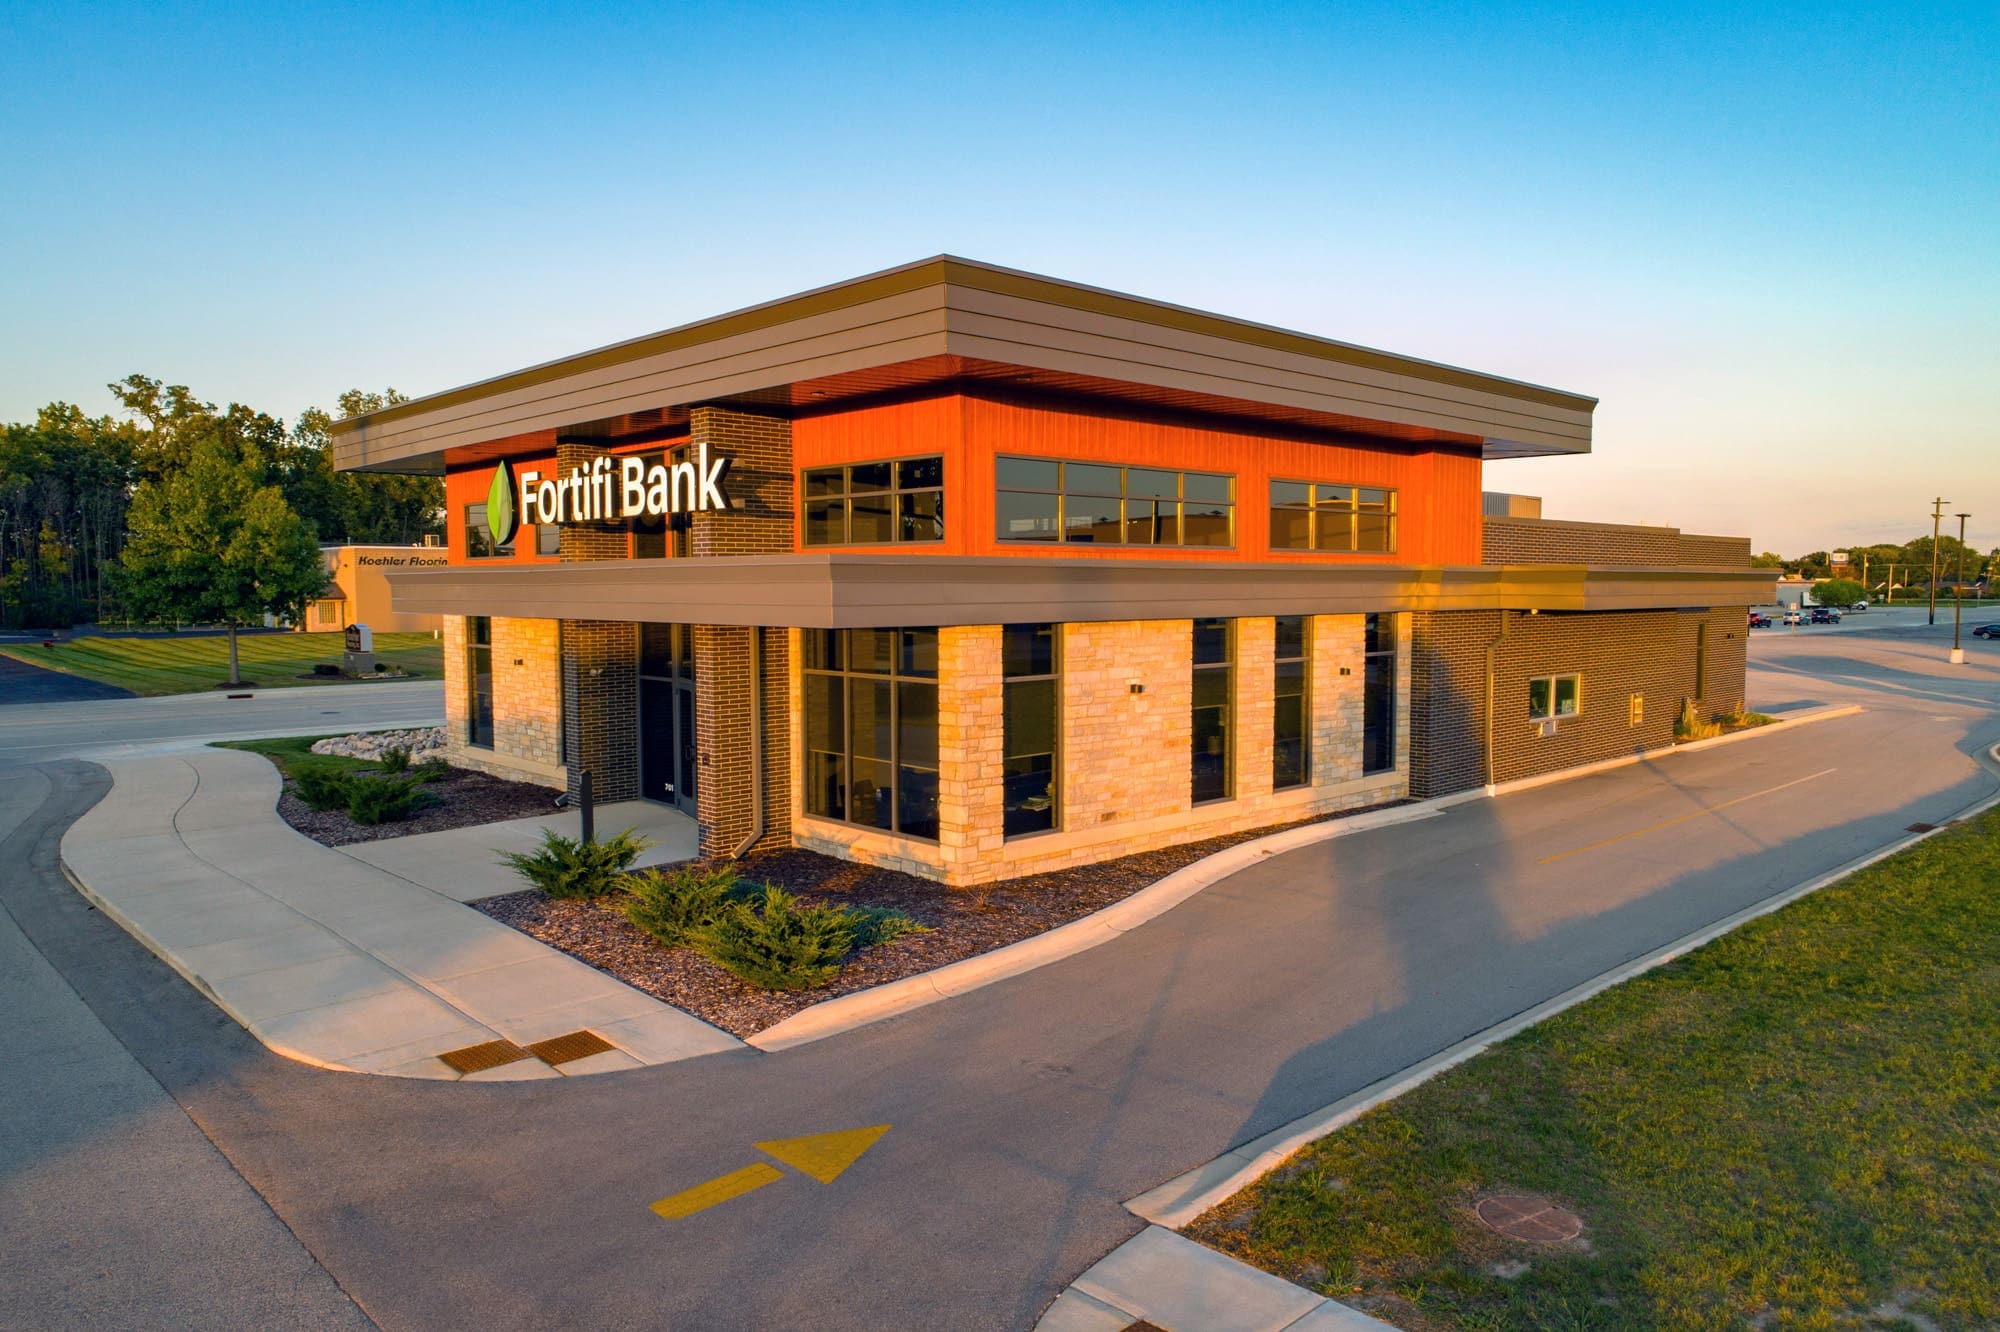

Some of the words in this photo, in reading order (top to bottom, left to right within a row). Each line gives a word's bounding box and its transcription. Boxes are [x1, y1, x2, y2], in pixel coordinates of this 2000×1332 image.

[520, 456, 613, 525] Fortifi
[621, 443, 726, 518] Bank
[358, 556, 406, 566] Koehler
